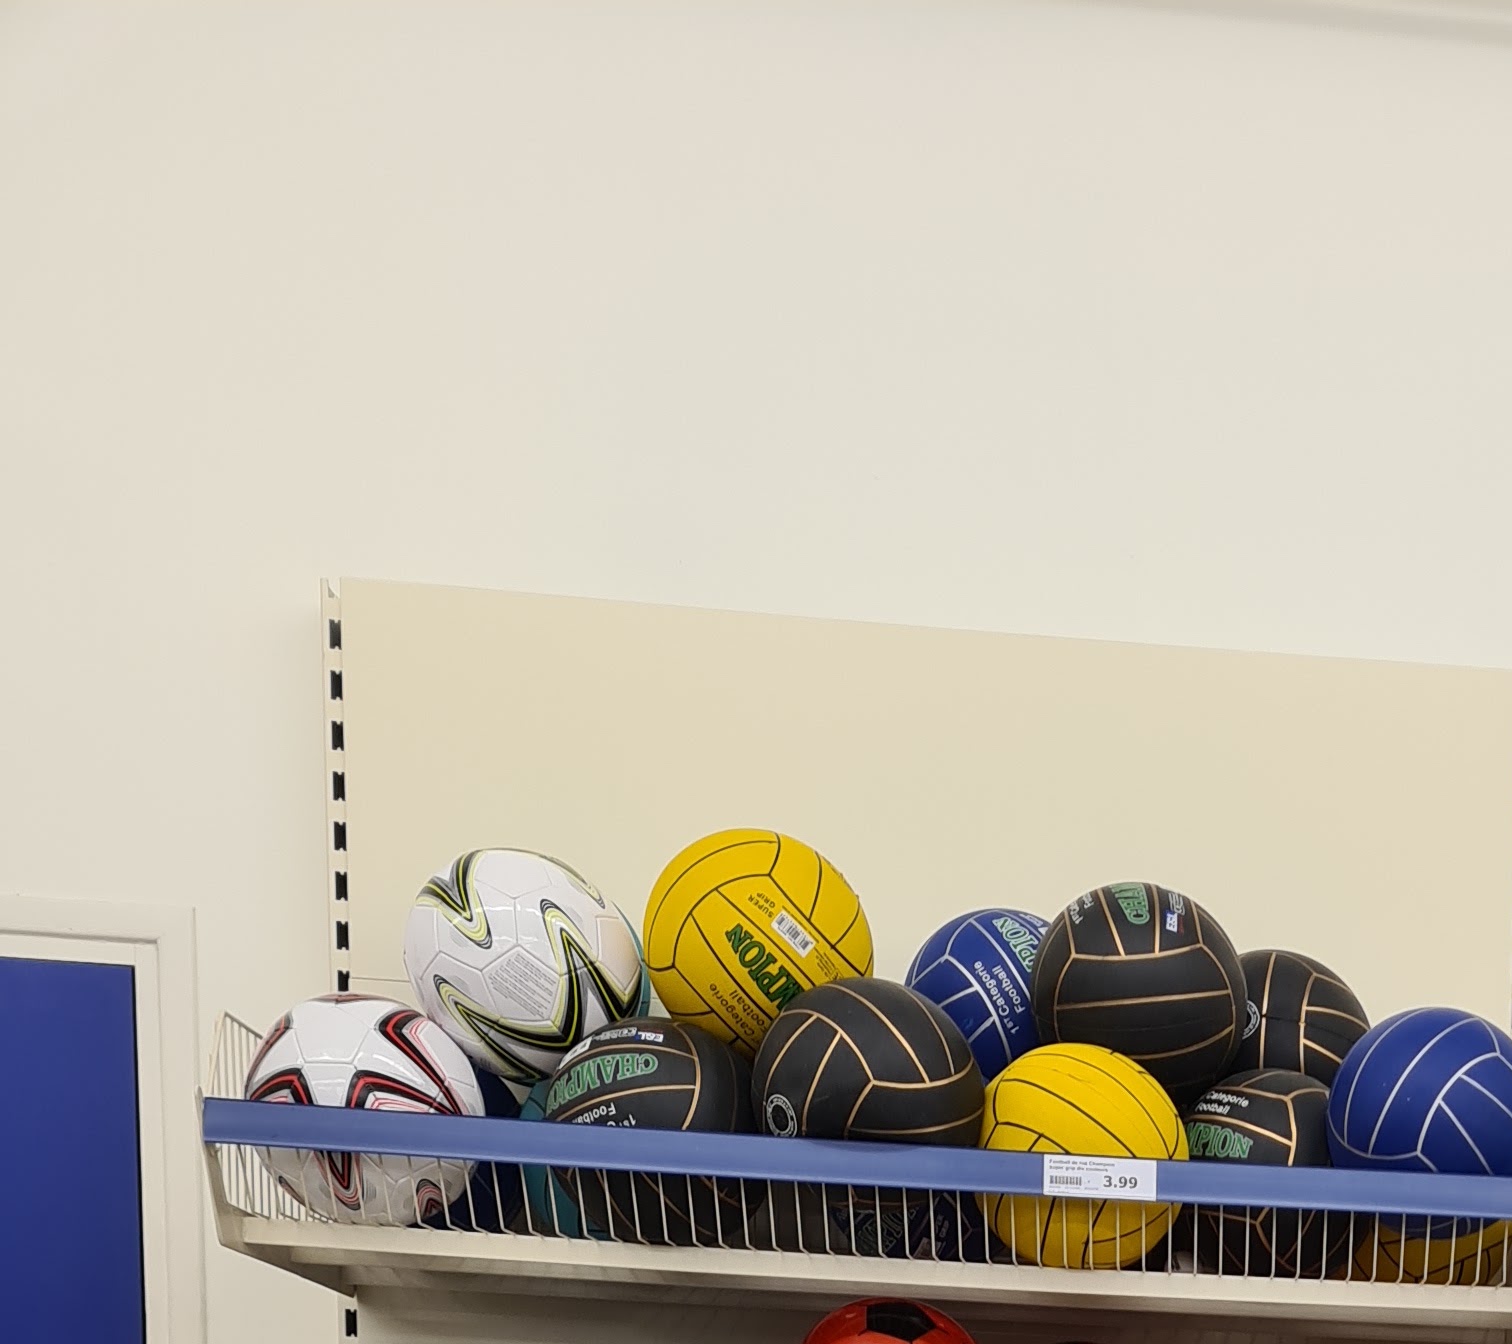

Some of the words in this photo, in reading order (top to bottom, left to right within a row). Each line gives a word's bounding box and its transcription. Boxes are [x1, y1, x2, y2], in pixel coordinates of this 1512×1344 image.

[725, 923, 804, 1011] MPION
[1186, 1121, 1254, 1159] MPION
[1103, 1174, 1138, 1189] 3.99
